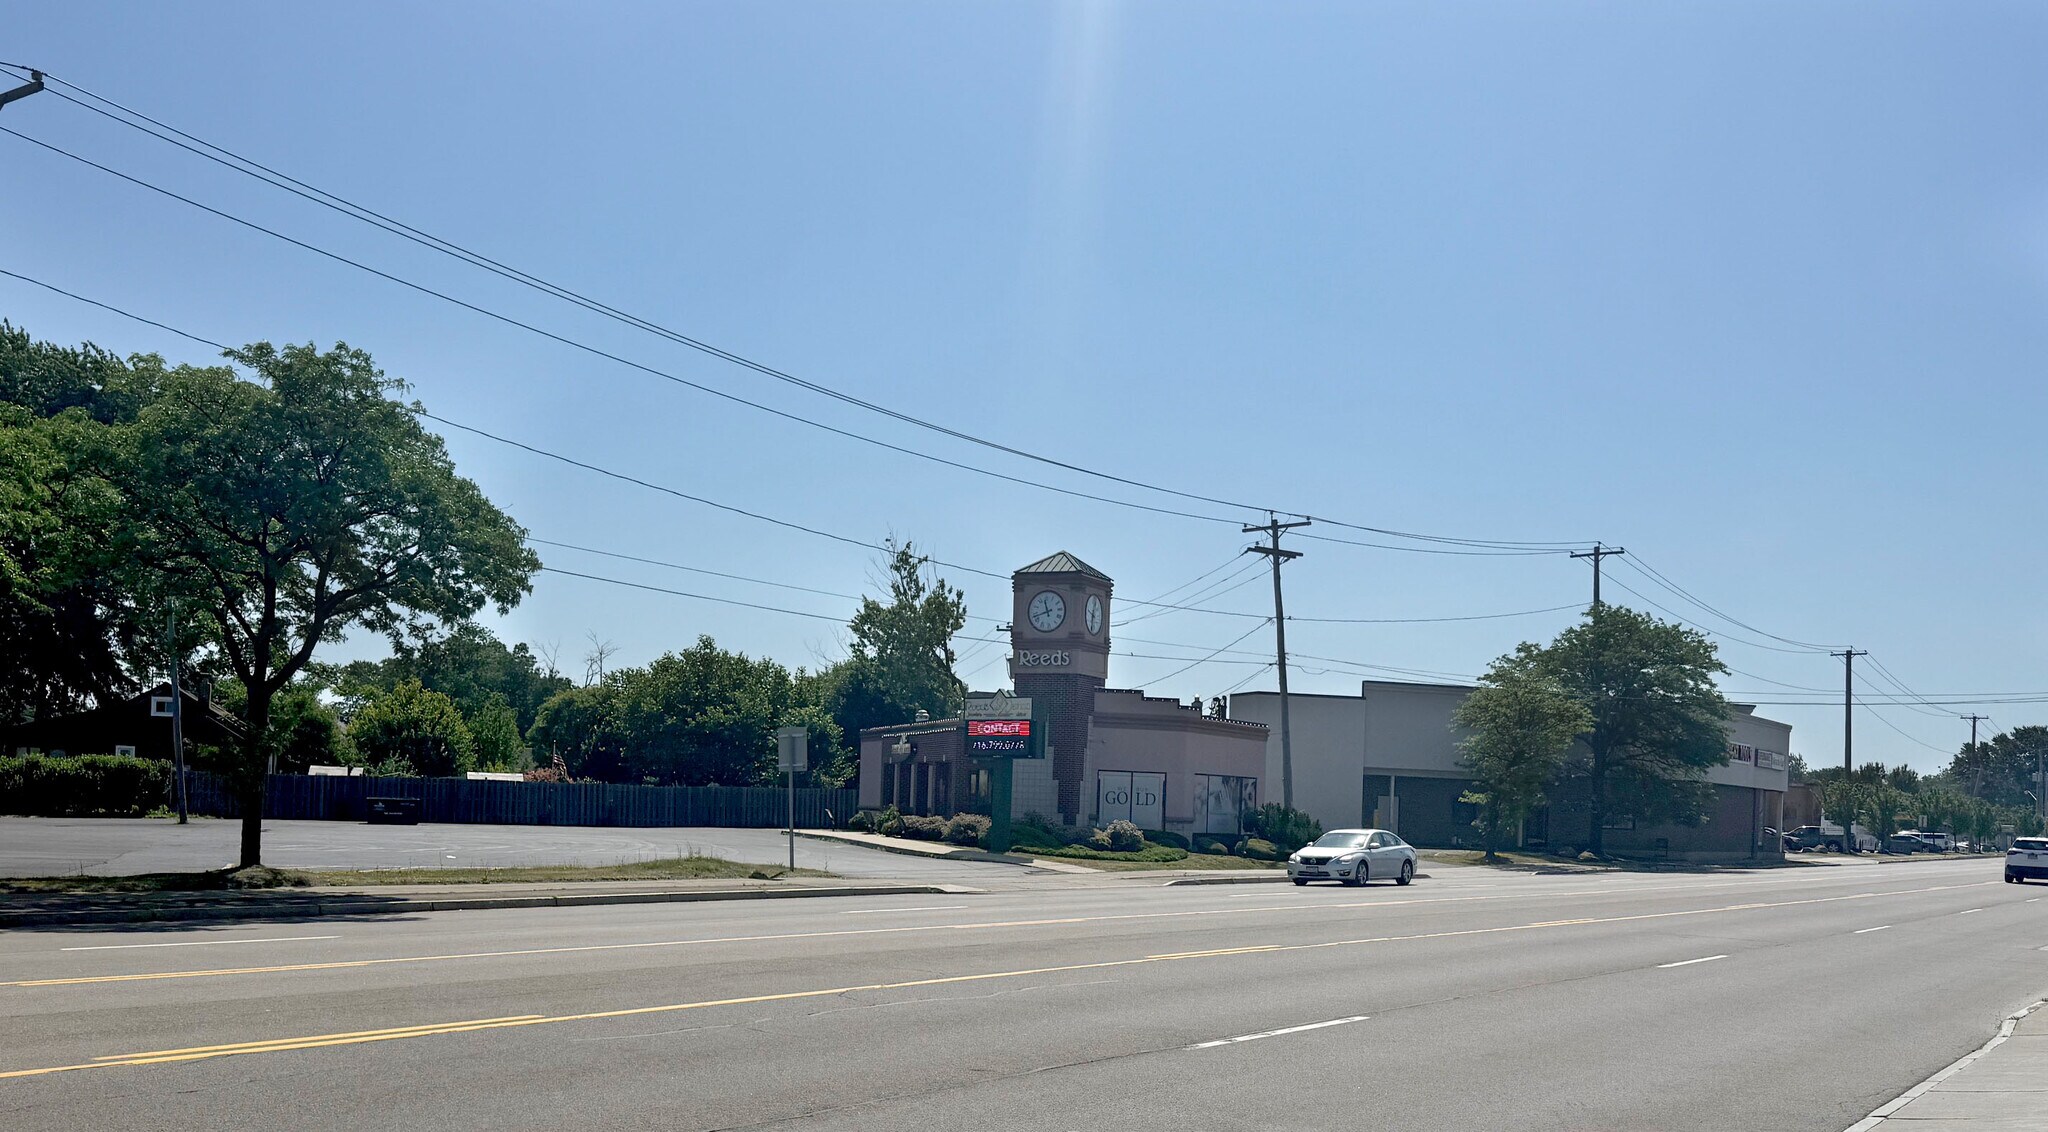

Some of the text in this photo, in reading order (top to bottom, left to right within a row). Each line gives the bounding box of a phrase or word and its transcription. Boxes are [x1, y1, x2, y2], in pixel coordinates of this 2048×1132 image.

[1018, 650, 1070, 667] Reeds
[977, 723, 1021, 734] CONTACT
[1105, 791, 1156, 806] GOLD
